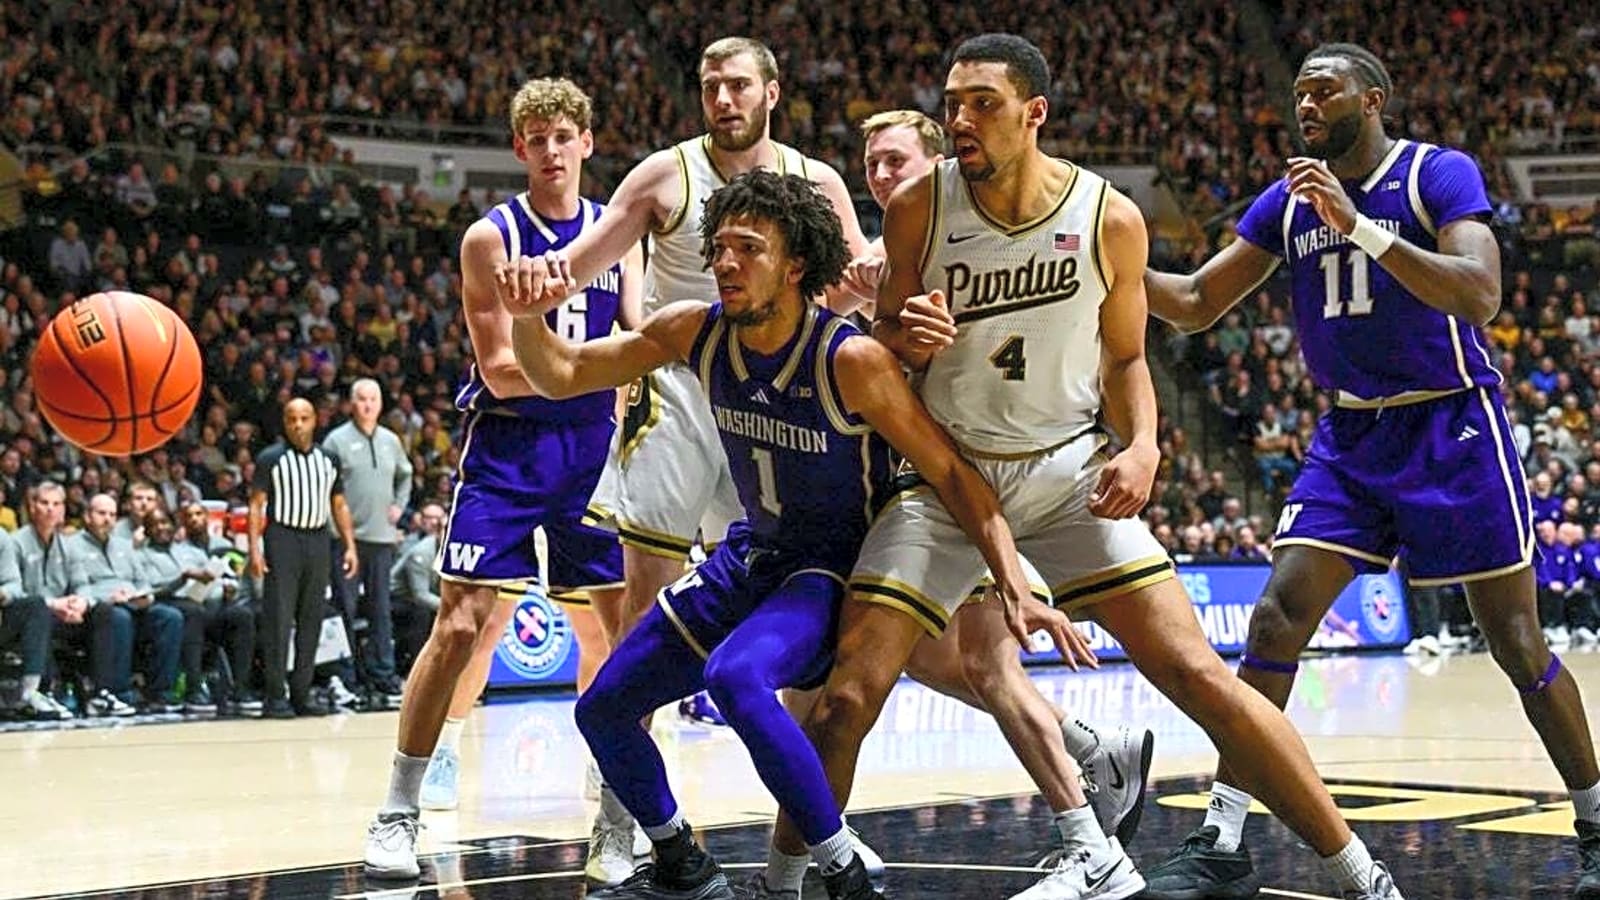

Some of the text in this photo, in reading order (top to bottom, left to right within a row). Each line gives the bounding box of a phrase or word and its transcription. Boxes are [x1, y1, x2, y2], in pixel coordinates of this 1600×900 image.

[1294, 219, 1400, 259] WASHON
[943, 252, 1081, 314] Purdue
[1320, 250, 1374, 319] 11
[556, 291, 588, 343] 6
[985, 332, 1026, 381] 4
[713, 404, 828, 453] WASHINGTON
[751, 447, 782, 517] 1
[449, 541, 486, 572] W
[1179, 573, 1211, 604] RS
[1192, 604, 1256, 645] MUN
